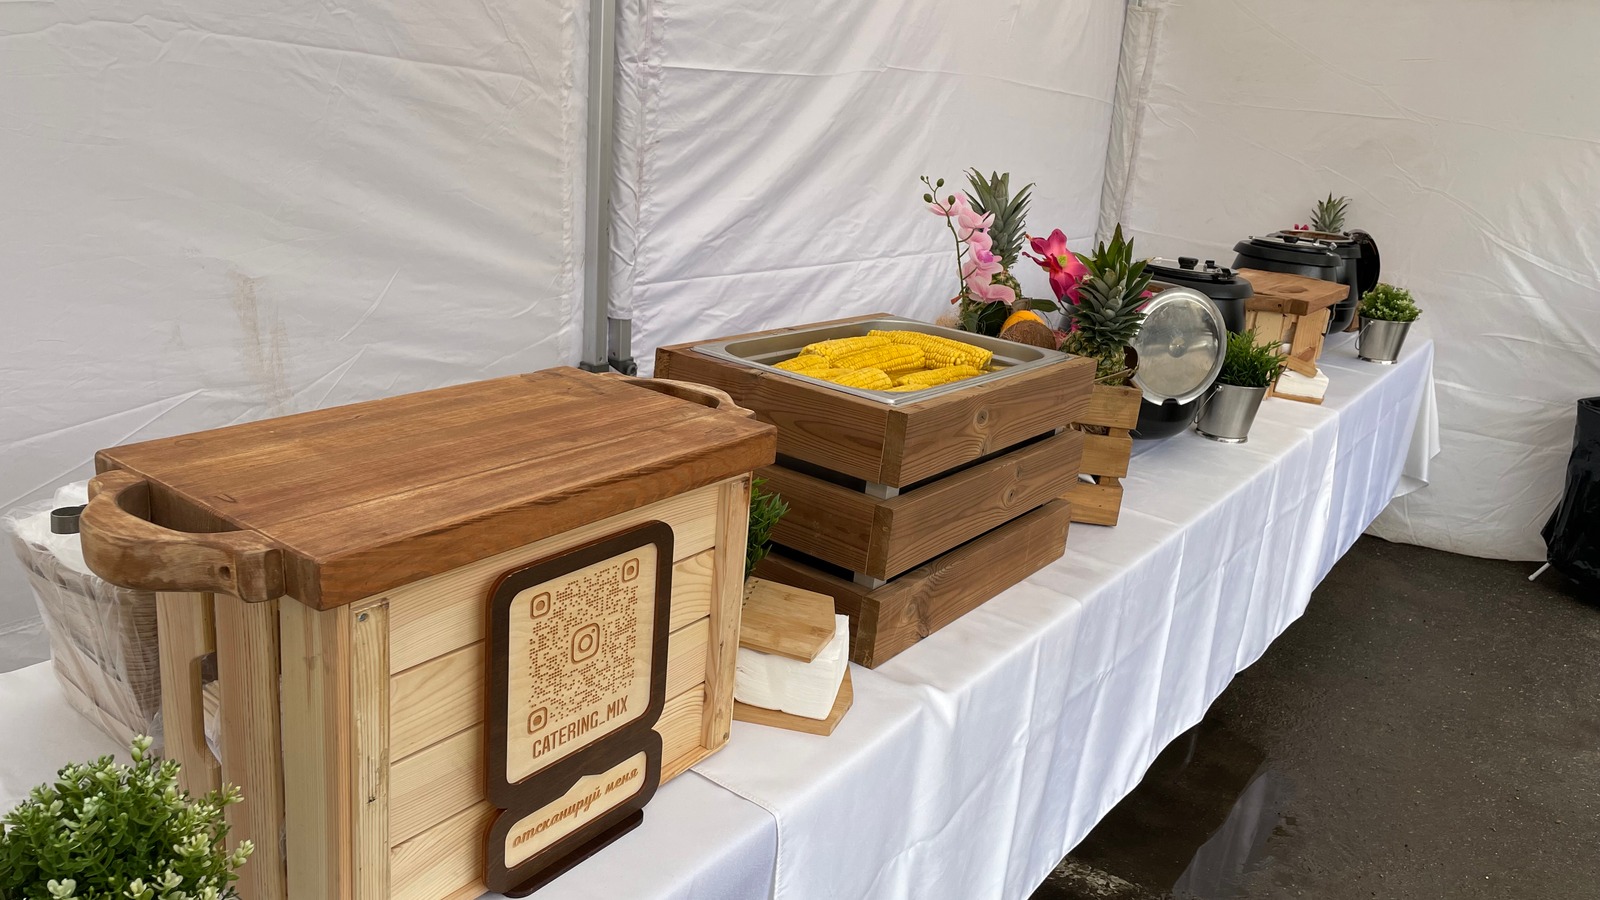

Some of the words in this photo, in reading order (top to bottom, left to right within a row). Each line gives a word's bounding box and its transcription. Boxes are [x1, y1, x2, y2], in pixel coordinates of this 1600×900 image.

[532, 695, 629, 760] CATERING_MIX
[512, 787, 602, 848] отсканируй
[604, 767, 639, 795] меня
